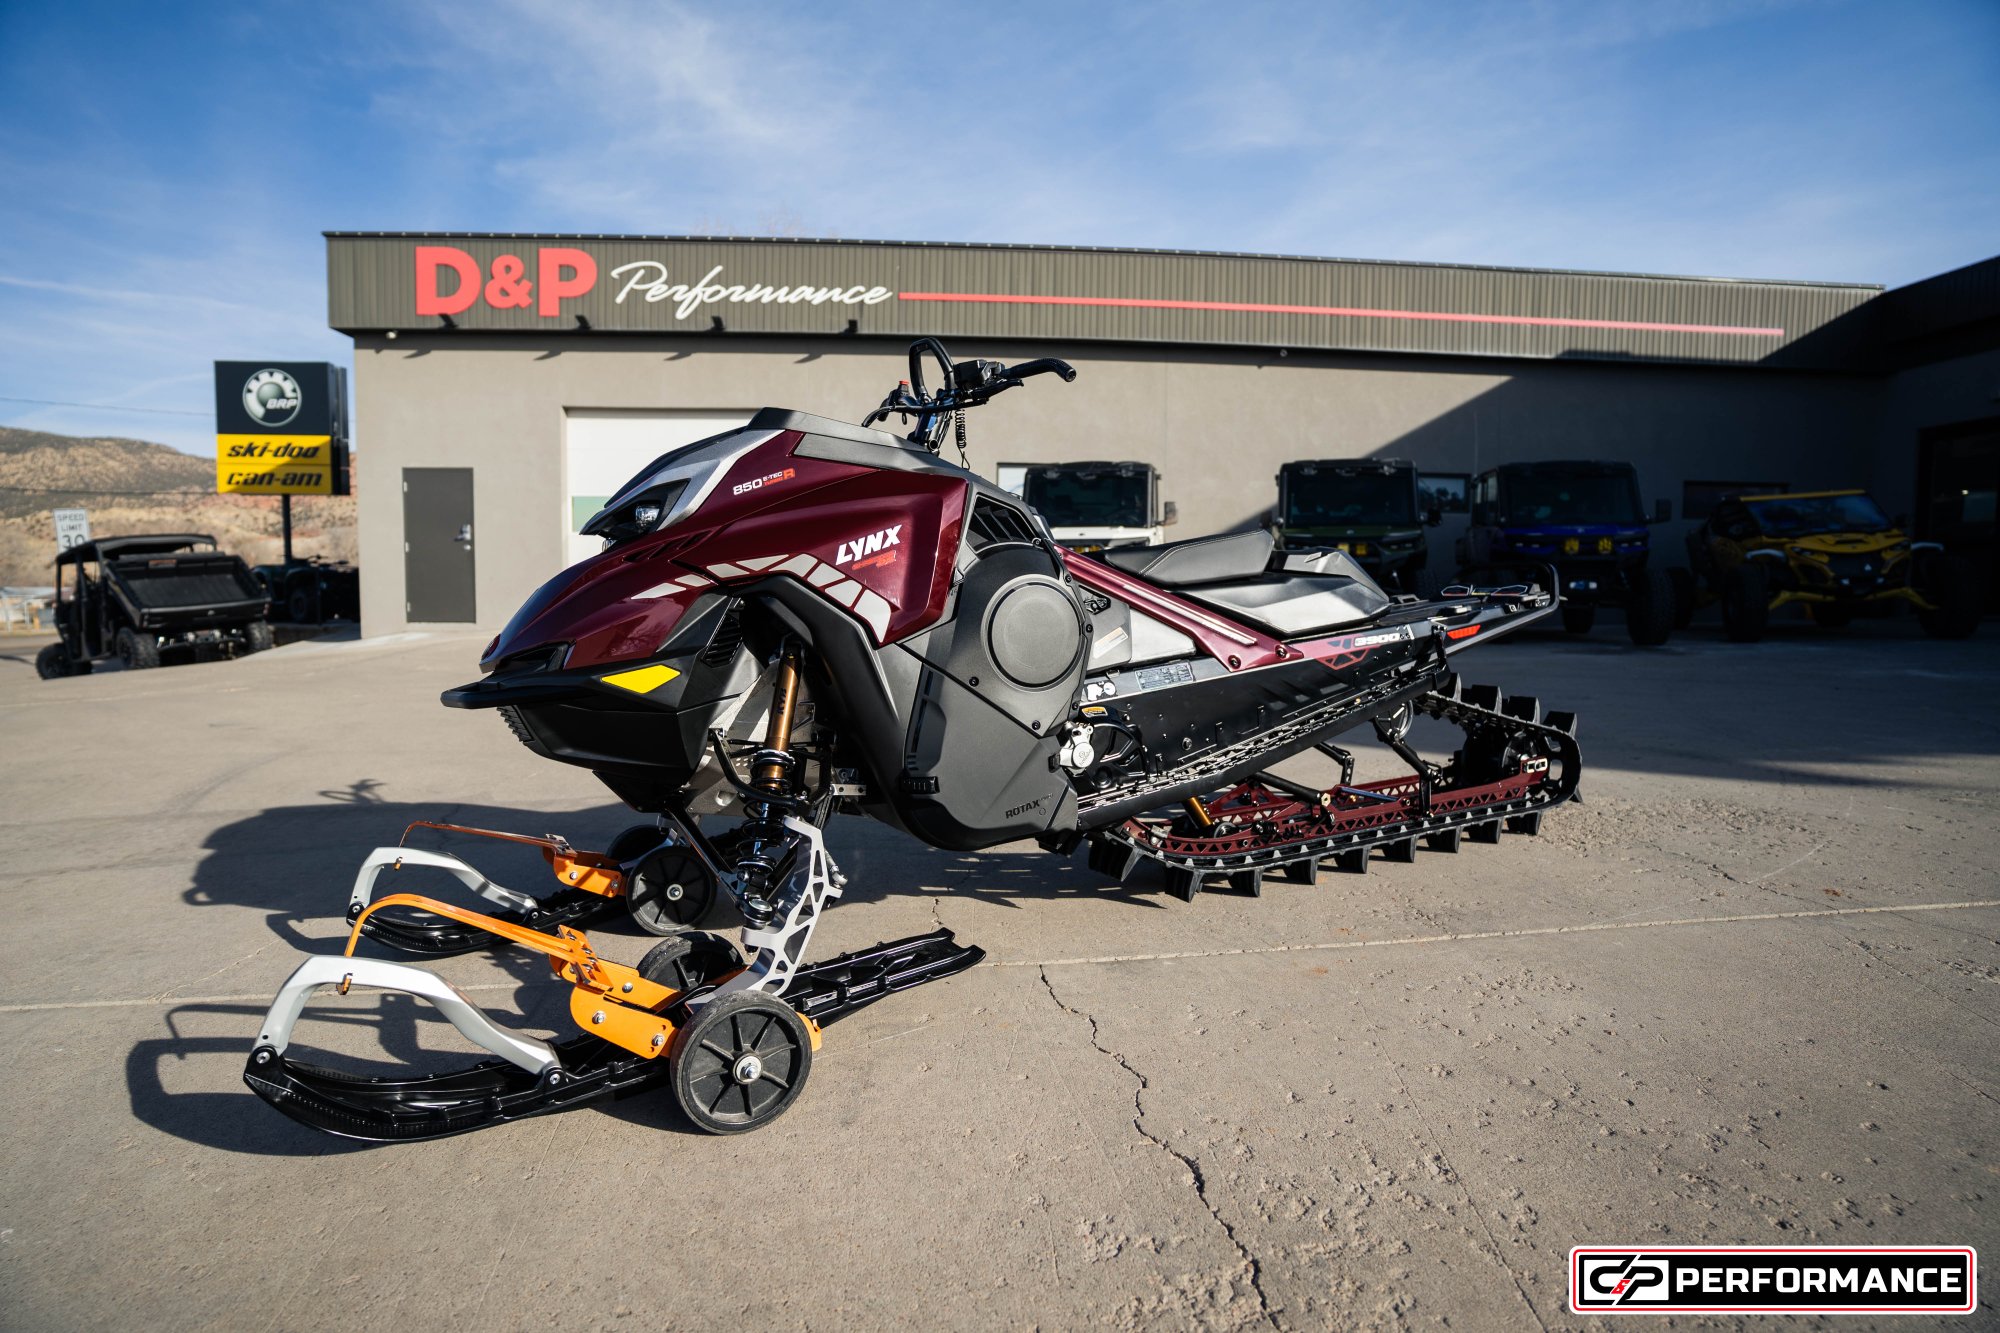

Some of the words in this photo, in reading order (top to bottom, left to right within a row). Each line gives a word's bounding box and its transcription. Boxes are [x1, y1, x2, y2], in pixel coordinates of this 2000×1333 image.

[415, 246, 597, 317] D&P
[611, 260, 893, 320] Performance
[266, 398, 298, 410] BRP
[226, 441, 319, 458] ski-doo
[226, 472, 322, 487] can-am
[733, 478, 762, 496] 850
[57, 513, 84, 522] SPEED
[61, 524, 82, 532] LIMIT
[62, 534, 85, 549] 30
[835, 524, 902, 566] LYNX
[1005, 799, 1040, 819] ROTAX
